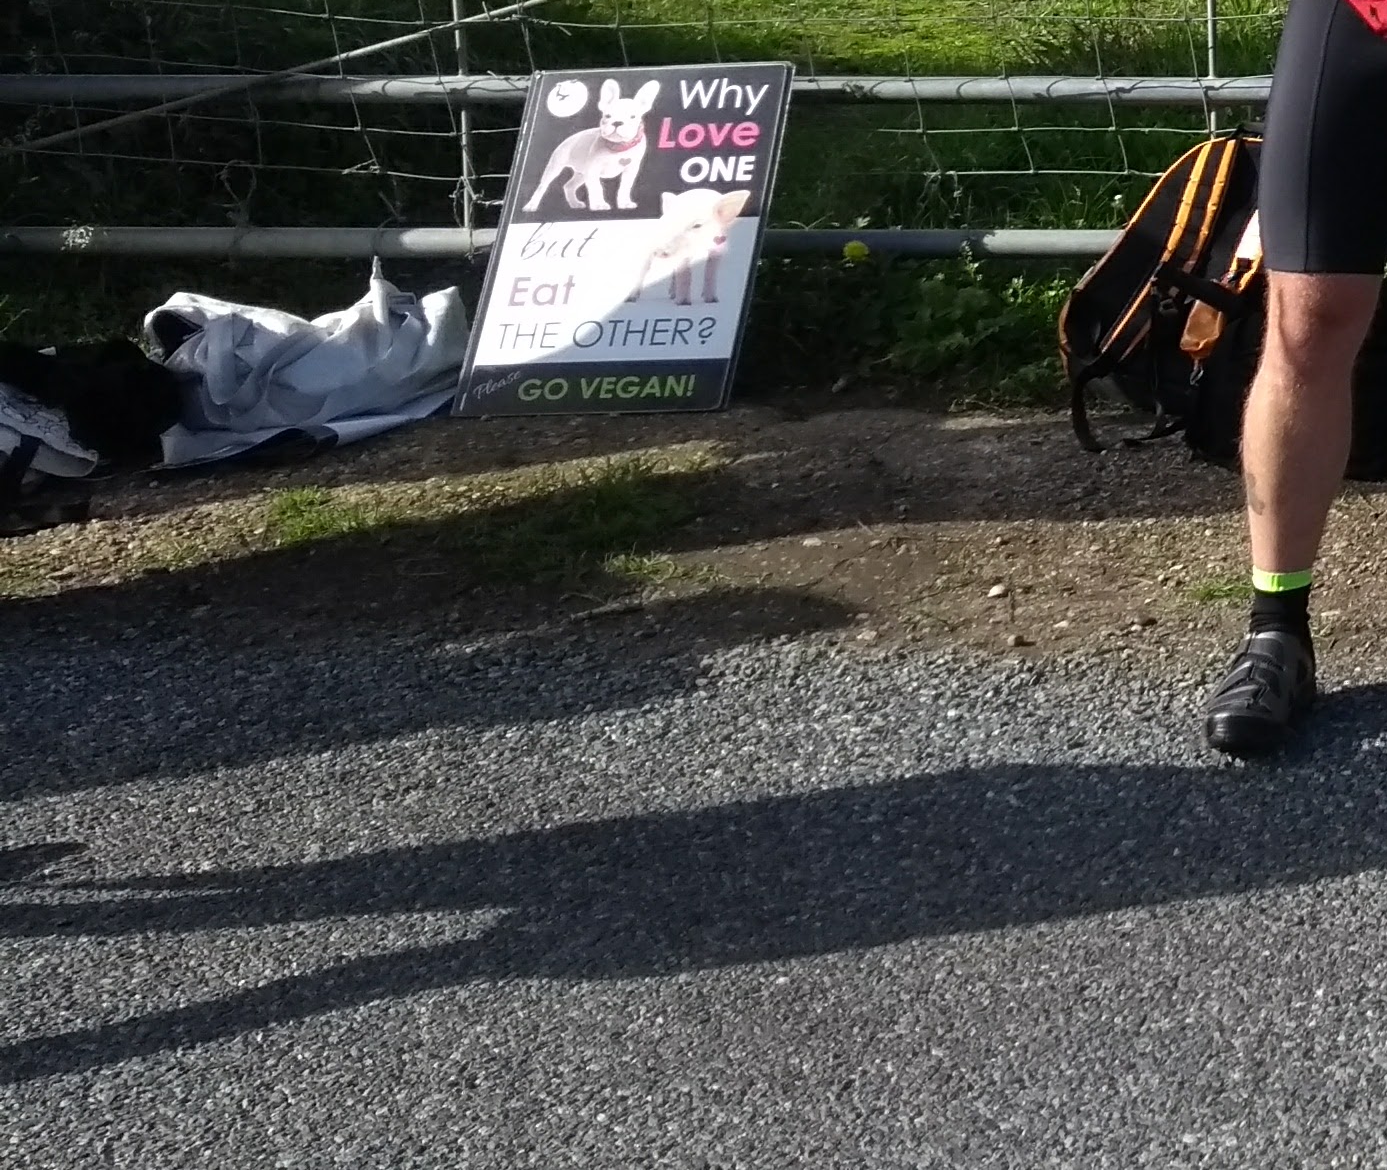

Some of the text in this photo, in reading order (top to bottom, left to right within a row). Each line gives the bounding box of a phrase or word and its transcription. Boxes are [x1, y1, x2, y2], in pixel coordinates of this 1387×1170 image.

[680, 78, 769, 116] Why
[658, 117, 760, 149] Love
[680, 156, 756, 183] ONE
[520, 222, 598, 261] but
[508, 274, 575, 307] Eat
[499, 316, 716, 349] THE OTHER?
[473, 371, 695, 401] Please GO VEGAN!
